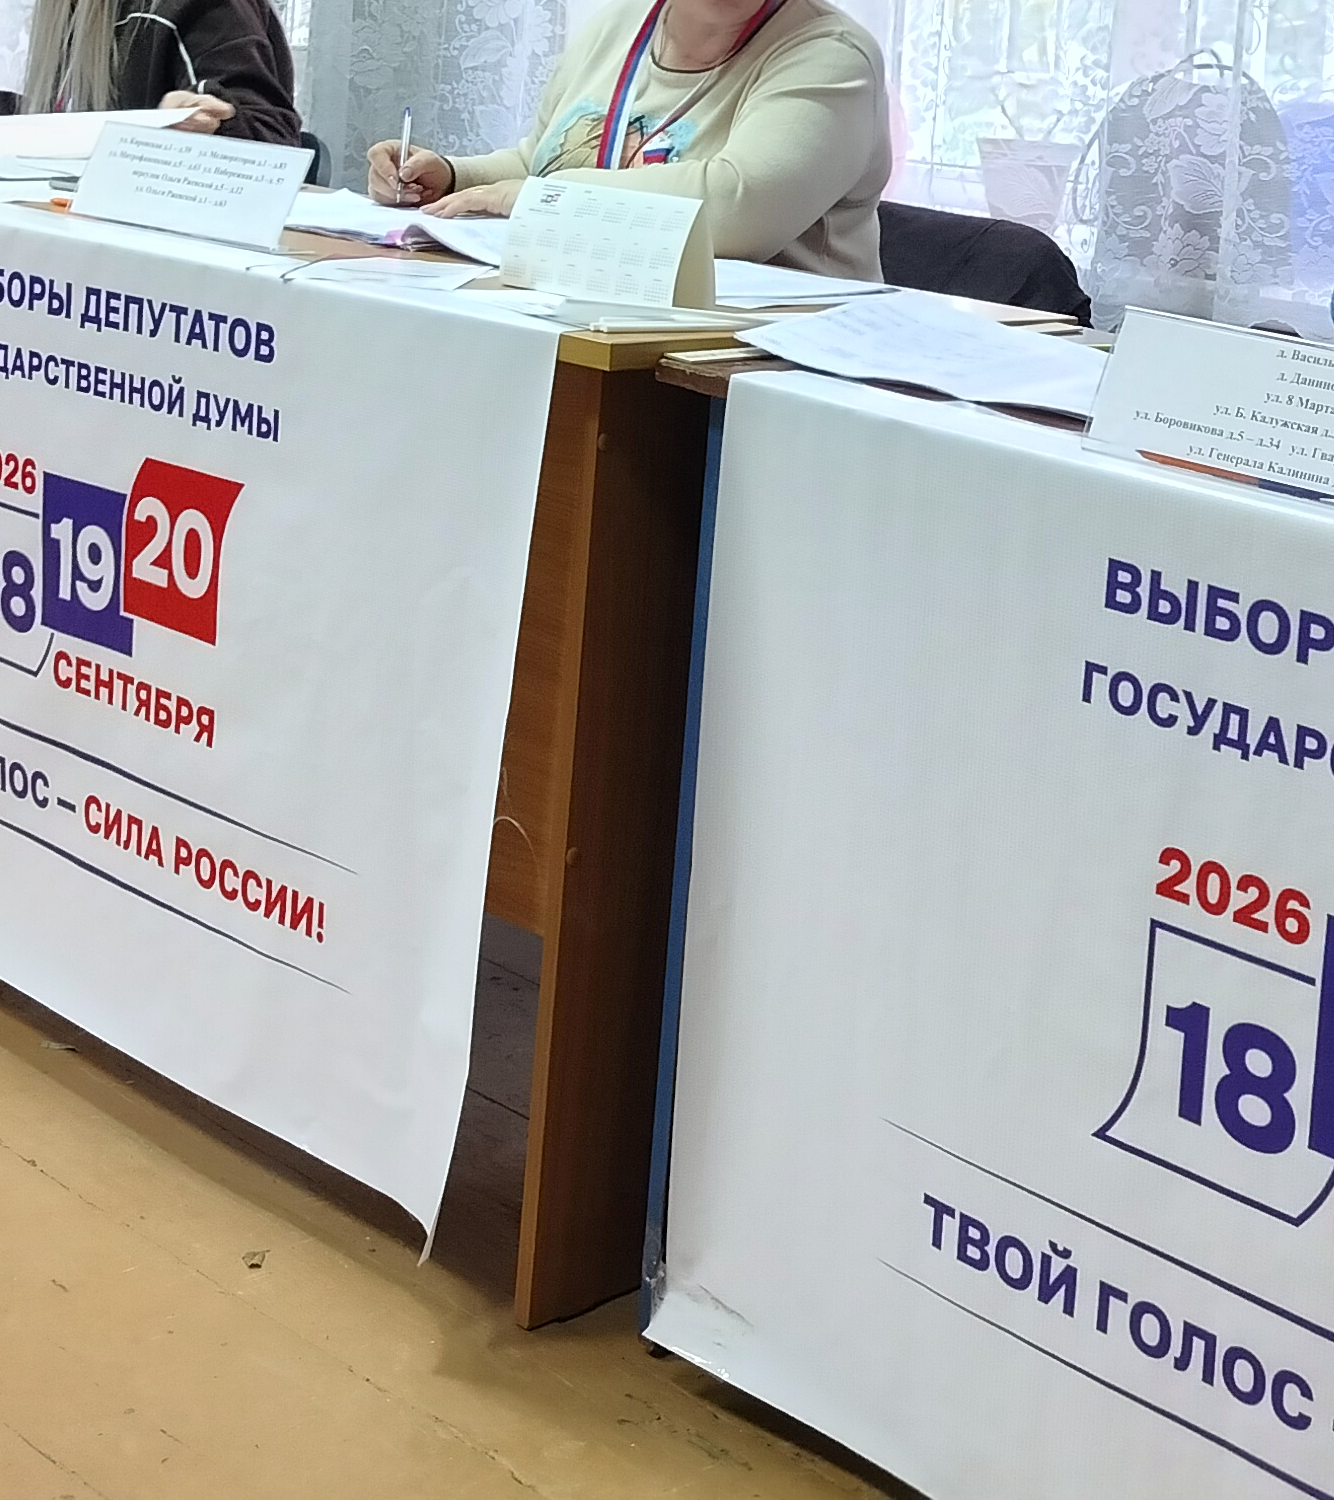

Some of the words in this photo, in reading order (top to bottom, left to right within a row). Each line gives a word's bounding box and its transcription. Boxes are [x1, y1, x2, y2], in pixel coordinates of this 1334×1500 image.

[145, 186, 166, 197] Ольги
[166, 190, 197, 202] Ржевской
[161, 173, 181, 184] Ольги
[182, 176, 213, 189] Ржевской
[80, 286, 275, 364] ДЕПУТАТОВ
[1276, 348, 1288, 359] д.
[1276, 372, 1288, 382] д.
[192, 390, 280, 443] ДУМЫ
[1212, 404, 1232, 416] ул.
[1235, 406, 1247, 420] Б.
[1250, 409, 1318, 436] Калужская
[1263, 392, 1282, 404] ул.
[1285, 394, 1295, 406] 8
[1133, 409, 1151, 421] ул.
[1154, 411, 1224, 438] Боровикова
[1225, 430, 1245, 442] д.5
[1254, 436, 1282, 450] д.34
[1288, 444, 1308, 457] ул.
[1186, 444, 1205, 457] ул.
[1208, 446, 1264, 471] Генерала
[1267, 460, 1329, 486] Калинина
[50, 517, 115, 612] 19
[131, 496, 214, 599] 20
[53, 650, 215, 748] СЕНТЯБРЯ
[57, 797, 76, 813] –
[84, 795, 164, 868] СИЛА
[174, 836, 326, 943] РОССИИ!
[1155, 846, 1311, 945] 2026
[1165, 1001, 1297, 1155] 18
[923, 1192, 1078, 1318] ТВОЙ
[1095, 1280, 1314, 1431] ГОЛОС
